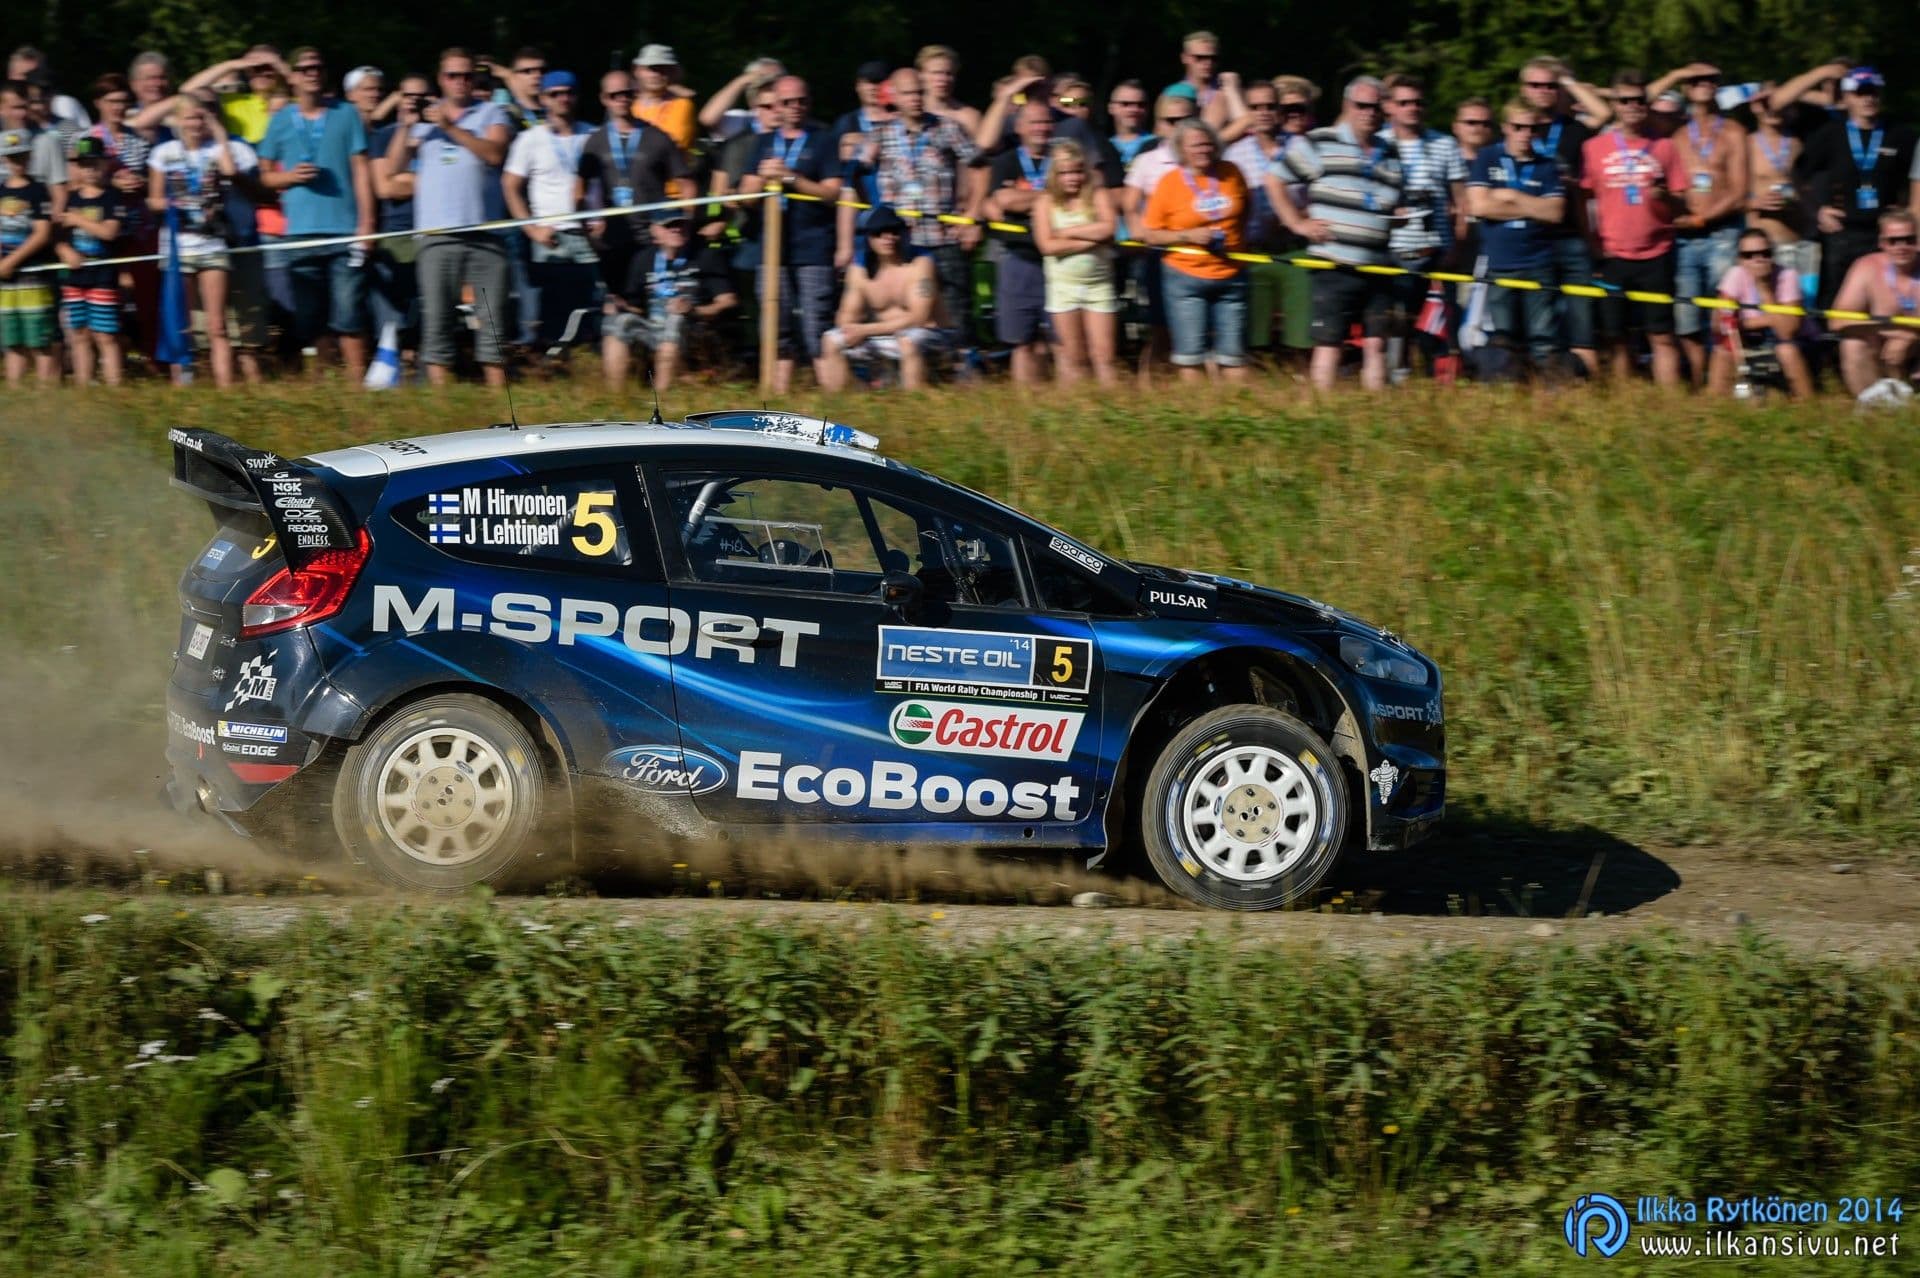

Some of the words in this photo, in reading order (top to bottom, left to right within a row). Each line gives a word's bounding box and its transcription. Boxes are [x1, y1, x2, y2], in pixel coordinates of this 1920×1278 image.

[246, 458, 271, 469] SWP
[272, 482, 302, 492] NGK
[274, 496, 316, 509] Eibach
[463, 487, 481, 515] M
[487, 488, 567, 517] Hirvonen
[287, 524, 329, 533] RECARO
[464, 518, 477, 545] J
[483, 517, 560, 546] Lehtinen
[571, 491, 618, 557] 5
[1052, 537, 1102, 571] sparco
[1149, 590, 1208, 609] PULSAR
[372, 584, 821, 668] M-SPORT
[887, 643, 978, 666] NESTE
[983, 649, 1022, 669] OIL
[1052, 645, 1073, 683] 5
[915, 682, 930, 692] FIA
[931, 683, 957, 694] World
[957, 685, 979, 697] Rally
[980, 687, 1039, 701] Championship
[230, 724, 285, 738] MICHELIN
[935, 708, 1069, 754] Castrol
[241, 744, 280, 757] EDGE
[623, 751, 705, 788] Ford
[736, 750, 1080, 821] EcoBoost
